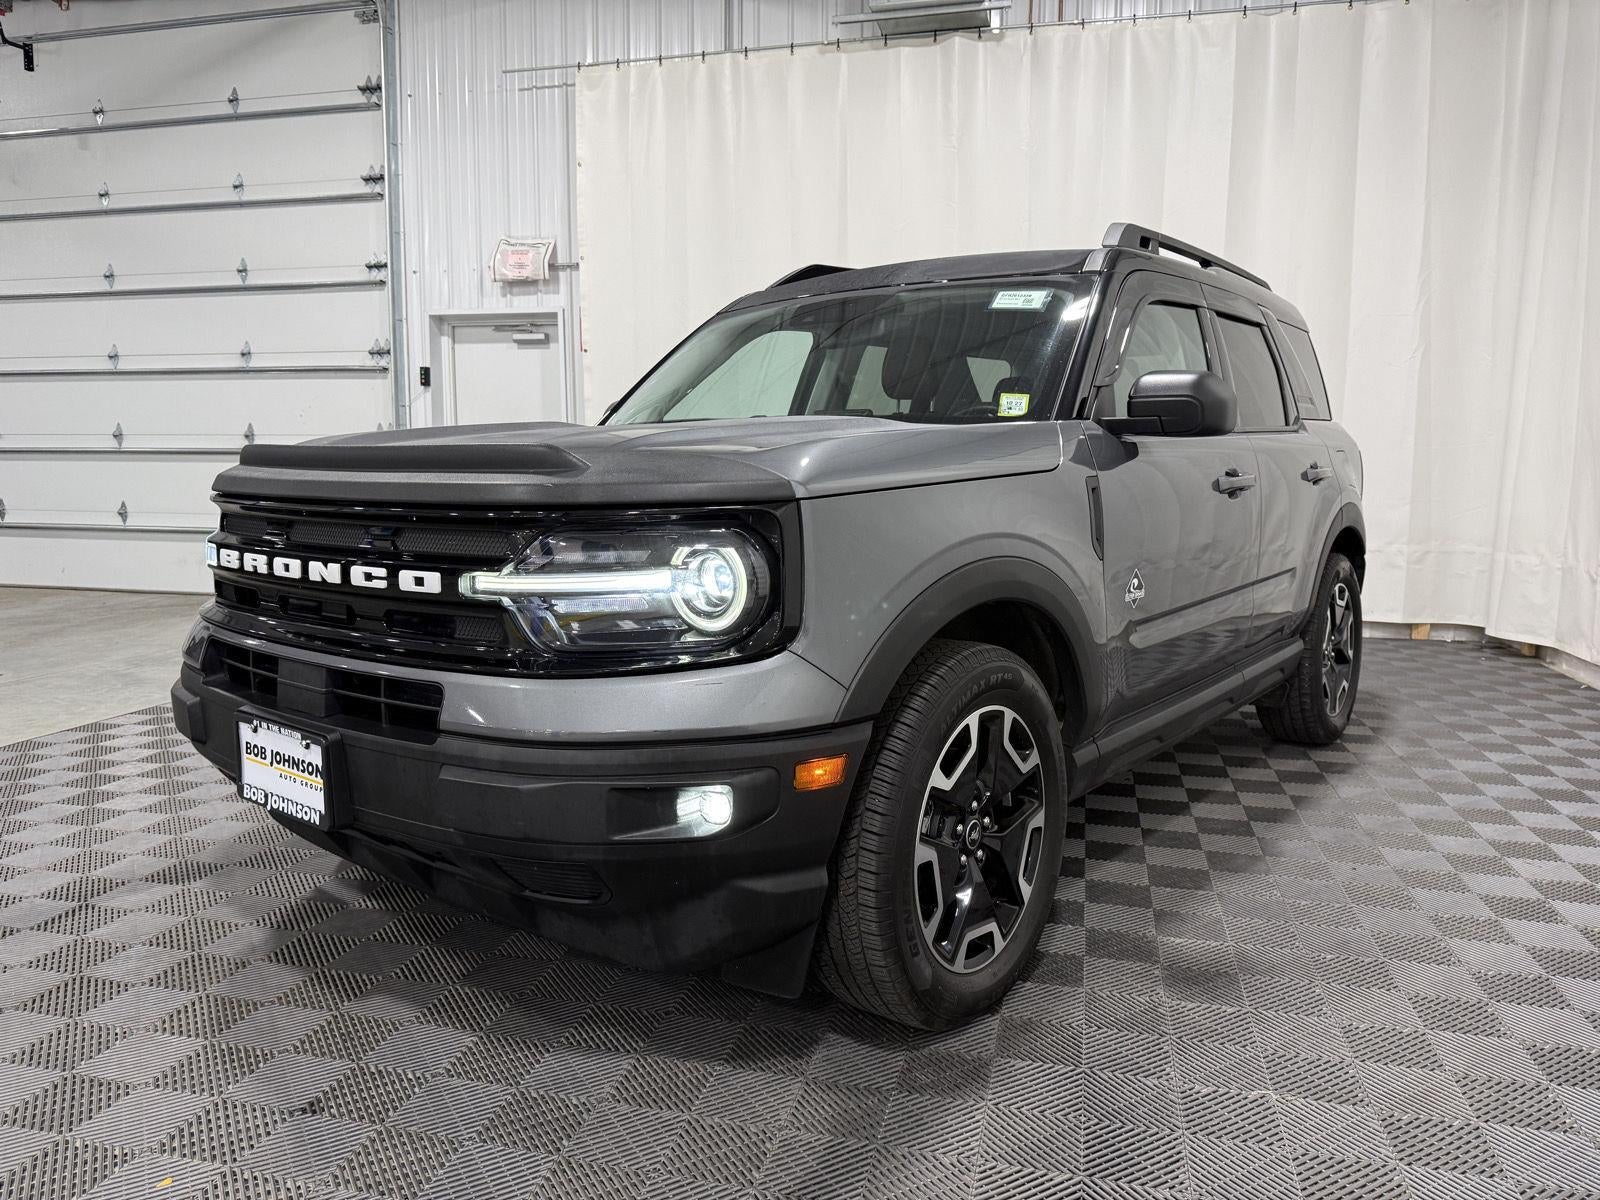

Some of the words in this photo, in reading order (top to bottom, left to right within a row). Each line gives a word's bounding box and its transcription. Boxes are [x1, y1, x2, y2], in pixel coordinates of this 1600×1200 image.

[219, 548, 442, 594] BRONCO
[261, 721, 268, 730] IN
[268, 723, 280, 734] THE
[280, 727, 302, 740] NATION
[245, 741, 267, 760] BOB
[270, 749, 322, 780] JOHNSON
[279, 772, 297, 784] AUTO
[300, 780, 323, 792] GROUP
[243, 783, 266, 804] BOB
[266, 792, 320, 826] JOHNSON
